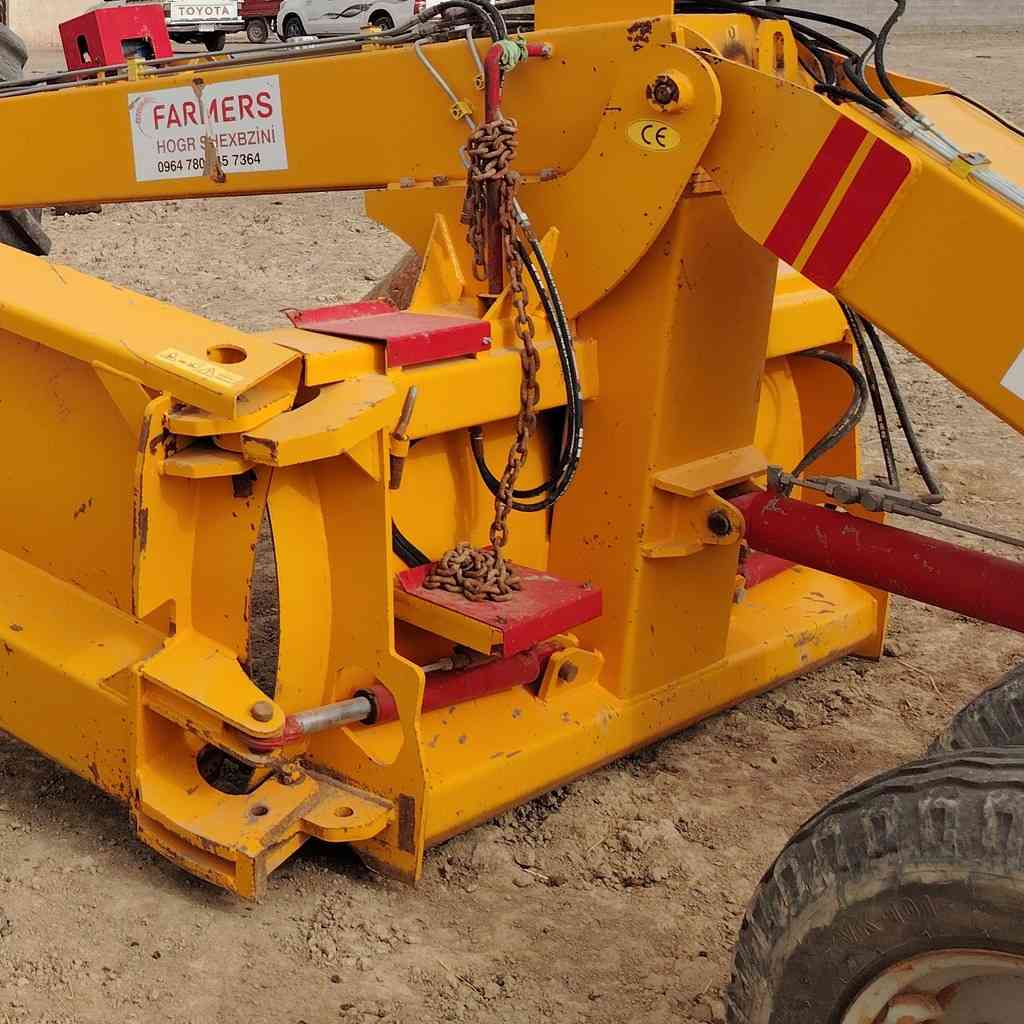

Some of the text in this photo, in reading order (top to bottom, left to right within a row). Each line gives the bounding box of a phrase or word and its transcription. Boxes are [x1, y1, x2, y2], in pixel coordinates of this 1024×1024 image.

[178, 6, 230, 16] TOYOTA
[156, 136, 197, 154] HOGR
[641, 124, 668, 148] CE
[157, 159, 184, 173] 0964
[232, 151, 261, 166] 7364
